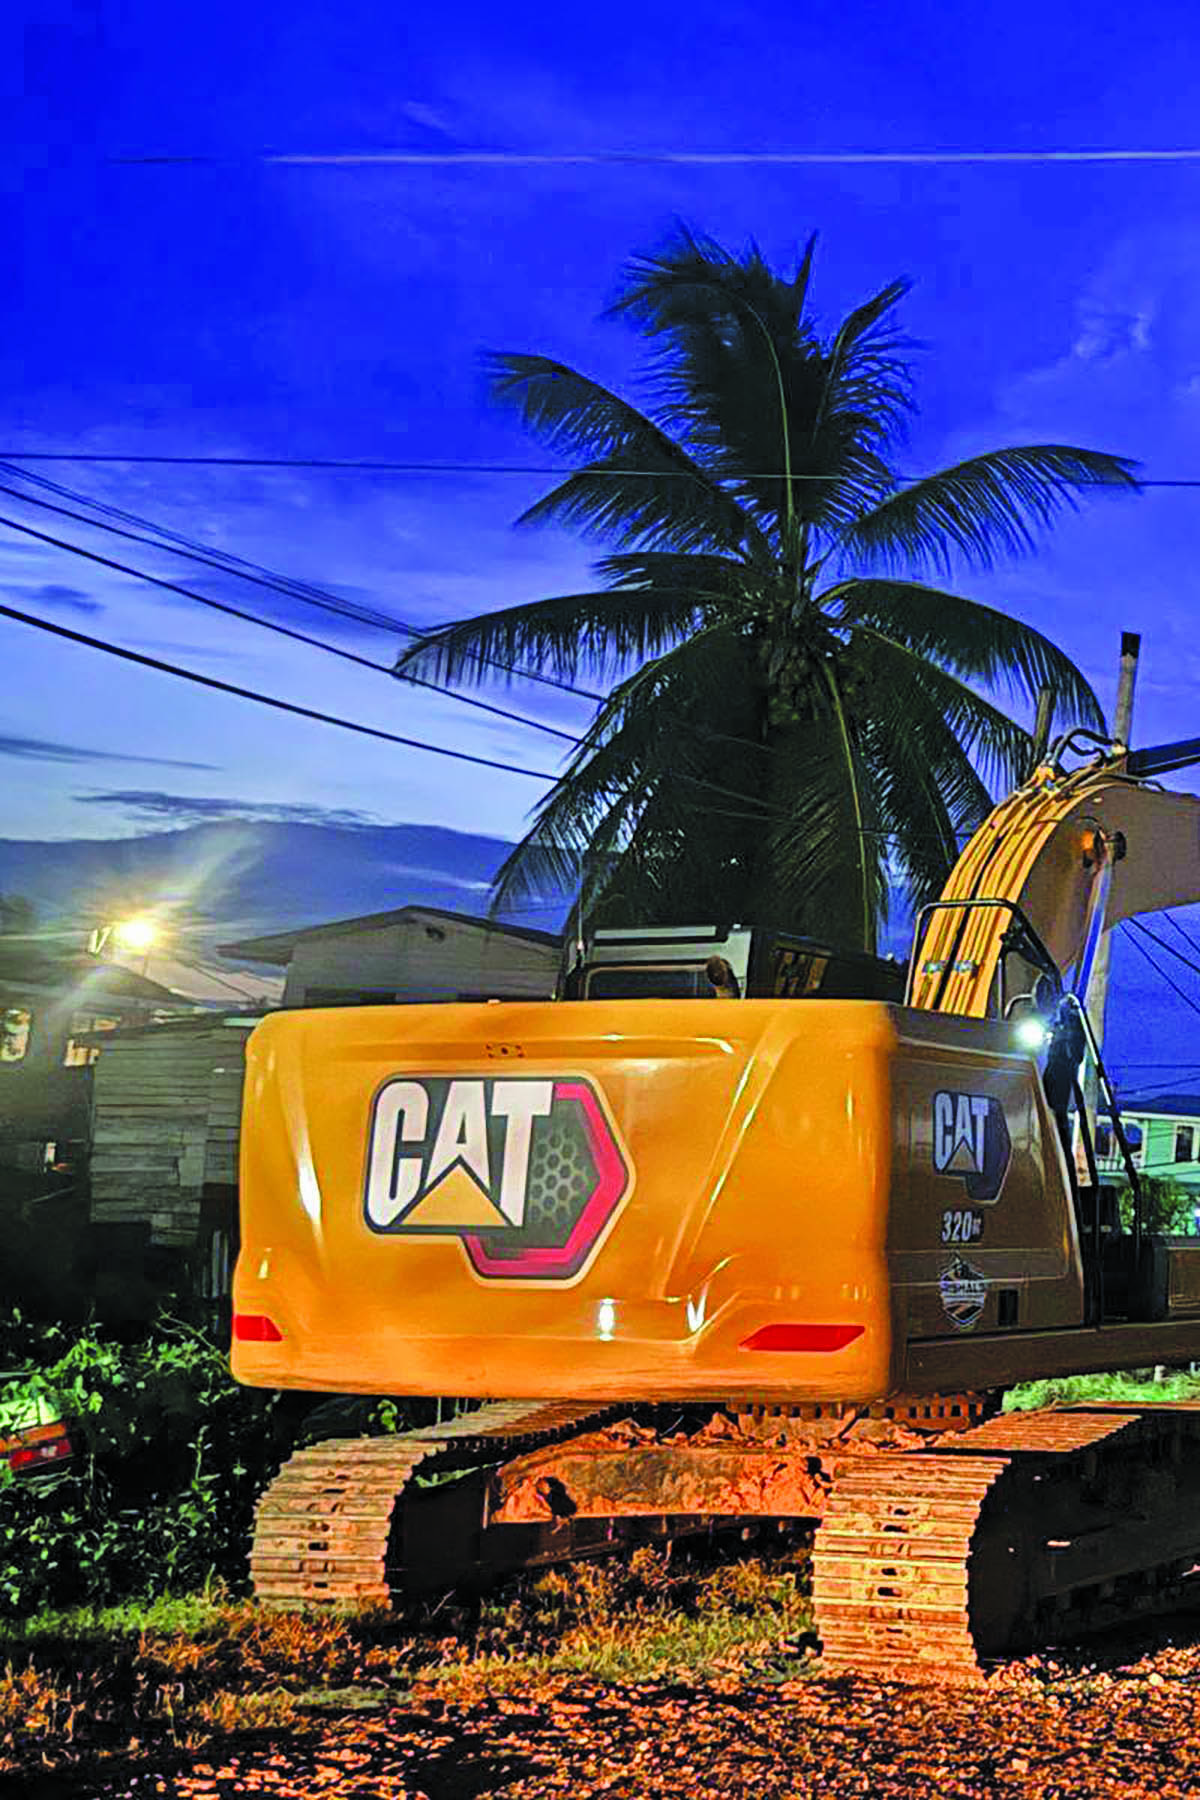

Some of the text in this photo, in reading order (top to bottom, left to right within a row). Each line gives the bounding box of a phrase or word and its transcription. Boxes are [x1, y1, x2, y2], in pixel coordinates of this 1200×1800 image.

[366, 1079, 554, 1228] CAT
[935, 1092, 989, 1173] CAT
[941, 1211, 972, 1241] 320
